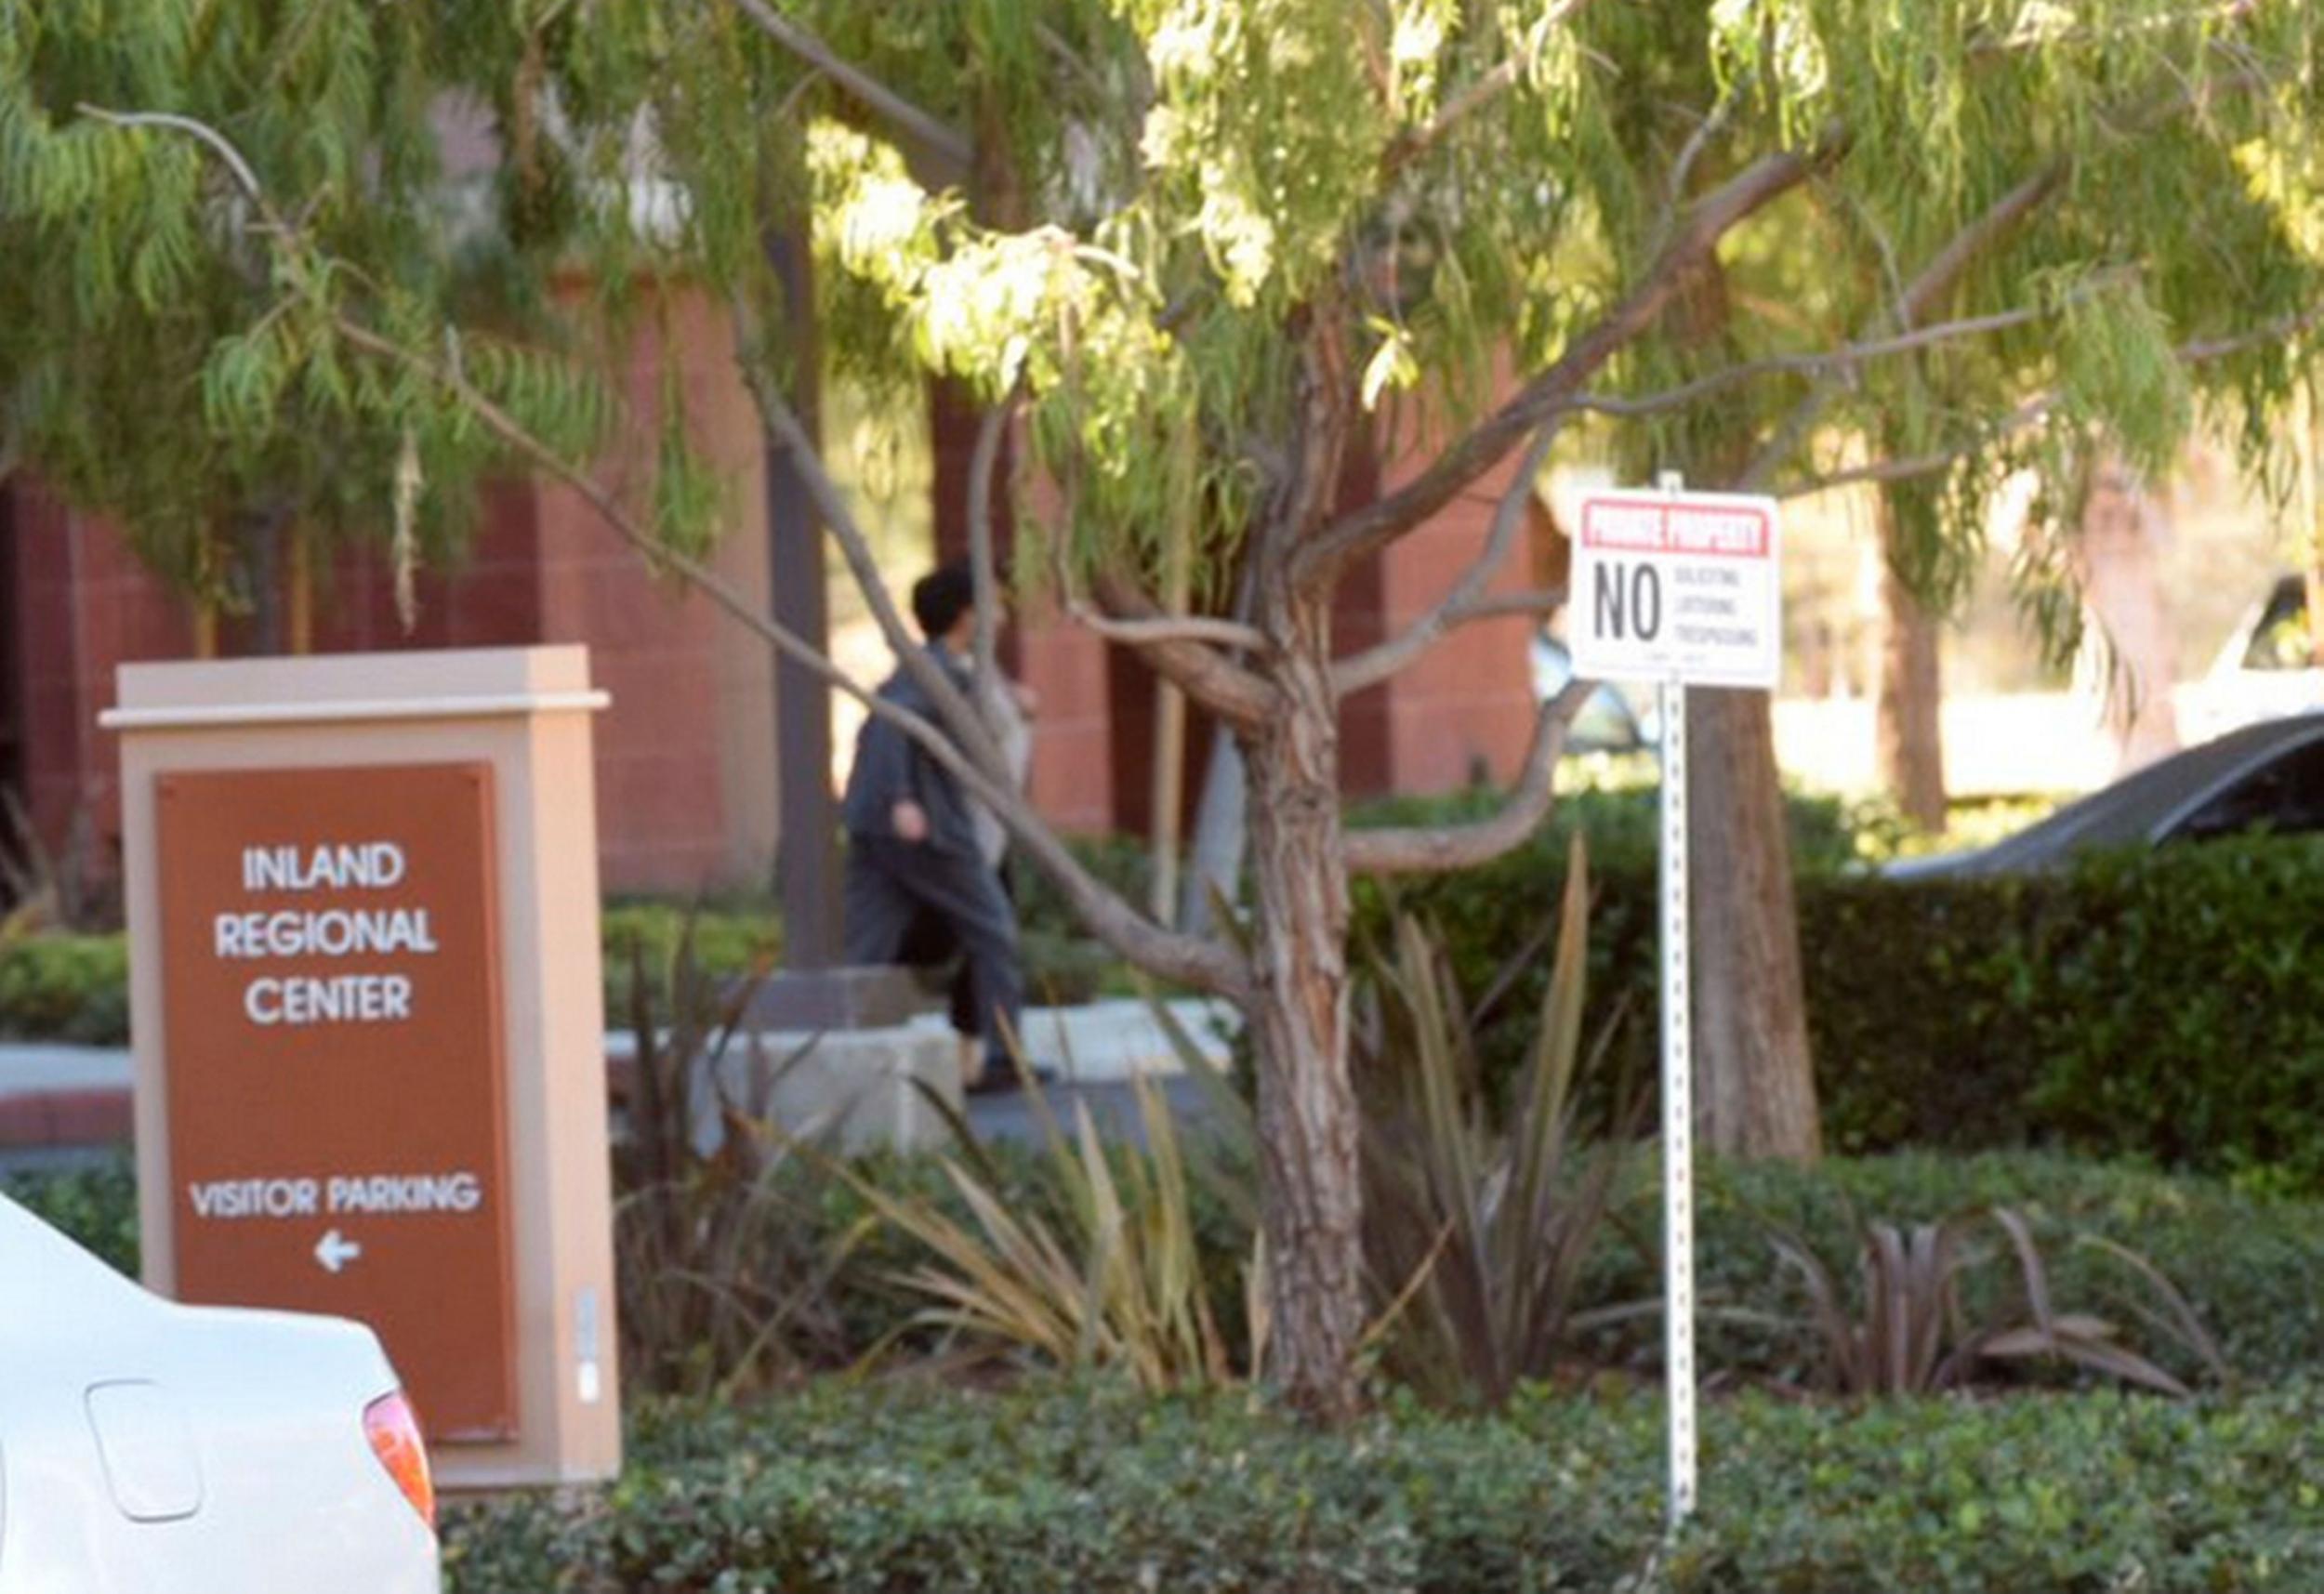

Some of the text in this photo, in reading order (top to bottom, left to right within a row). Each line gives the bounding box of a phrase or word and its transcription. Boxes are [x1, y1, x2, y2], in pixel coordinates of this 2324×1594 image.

[1593, 561, 1661, 641] NO
[243, 843, 404, 889] INLAND
[215, 909, 437, 956] REGIONAL
[244, 974, 411, 1024] CENTER
[190, 1172, 481, 1217] VISITOR PARKING
